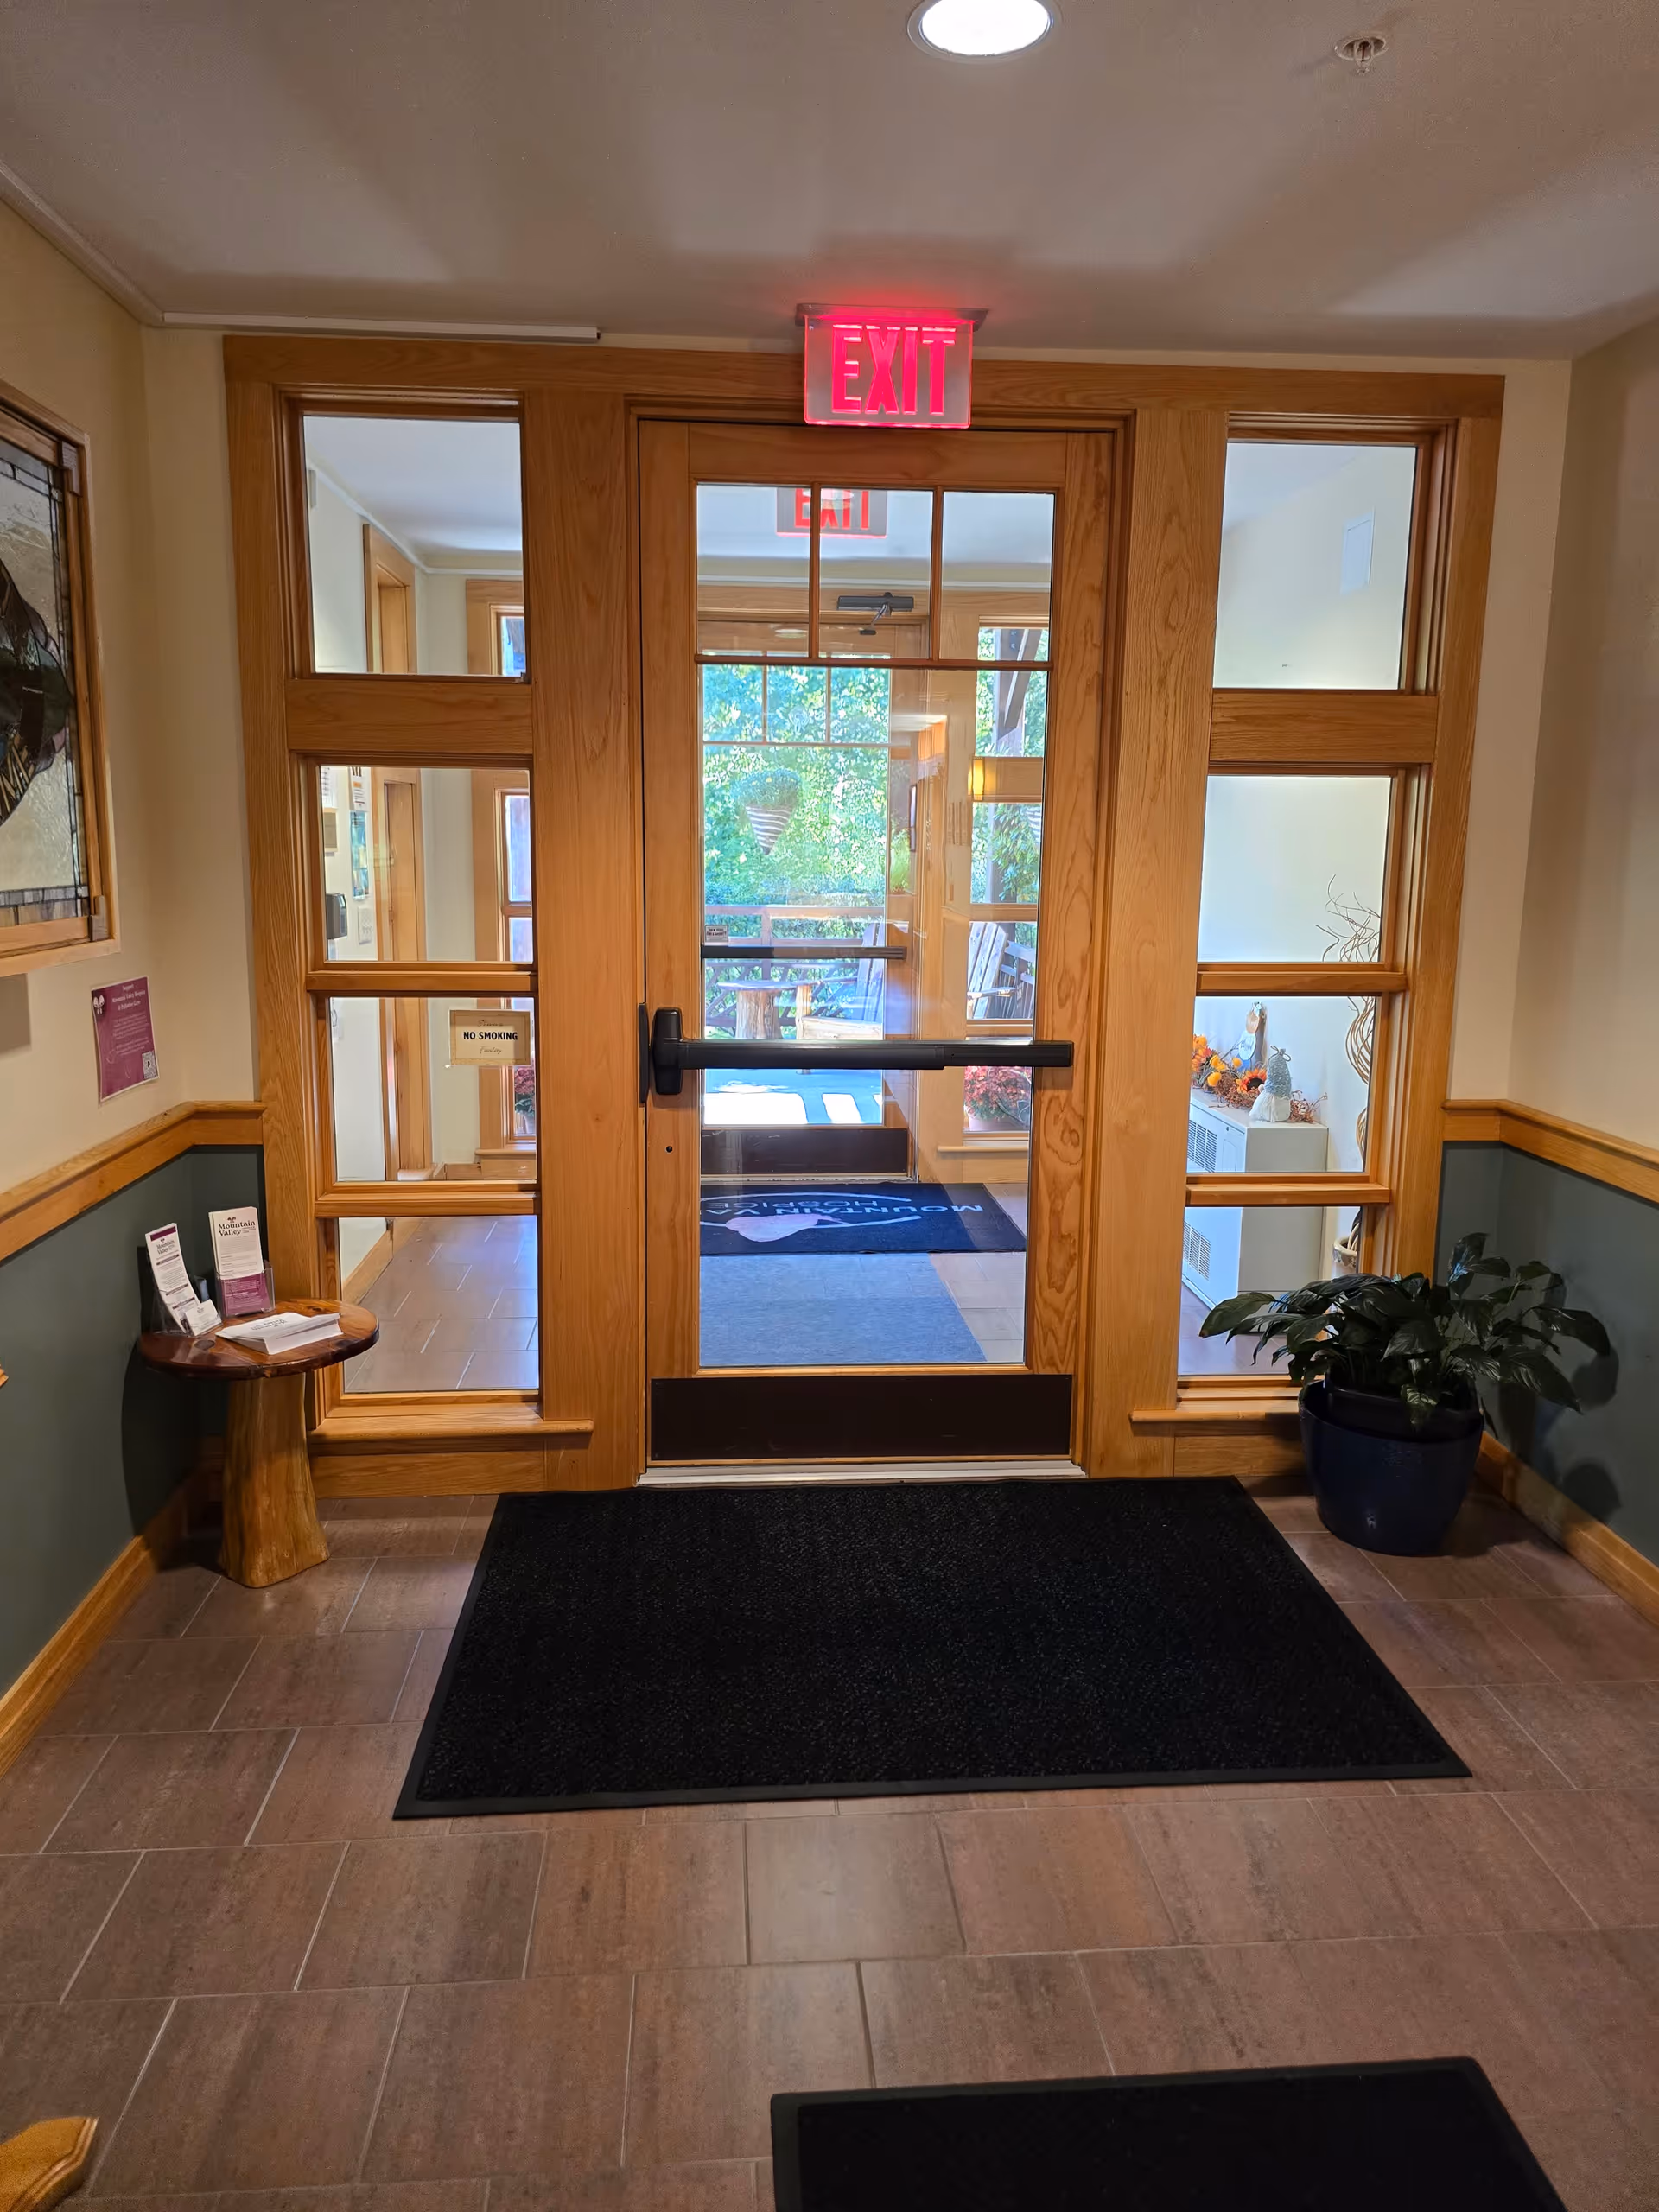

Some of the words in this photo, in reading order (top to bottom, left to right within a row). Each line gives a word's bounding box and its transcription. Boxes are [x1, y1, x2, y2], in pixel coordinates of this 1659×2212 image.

[832, 324, 956, 416] EXIT
[463, 1031, 476, 1040] NO
[479, 1032, 518, 1040] SMOKING
[776, 1205, 984, 1215] MOUNTAIN
[218, 1219, 256, 1230] Mountain
